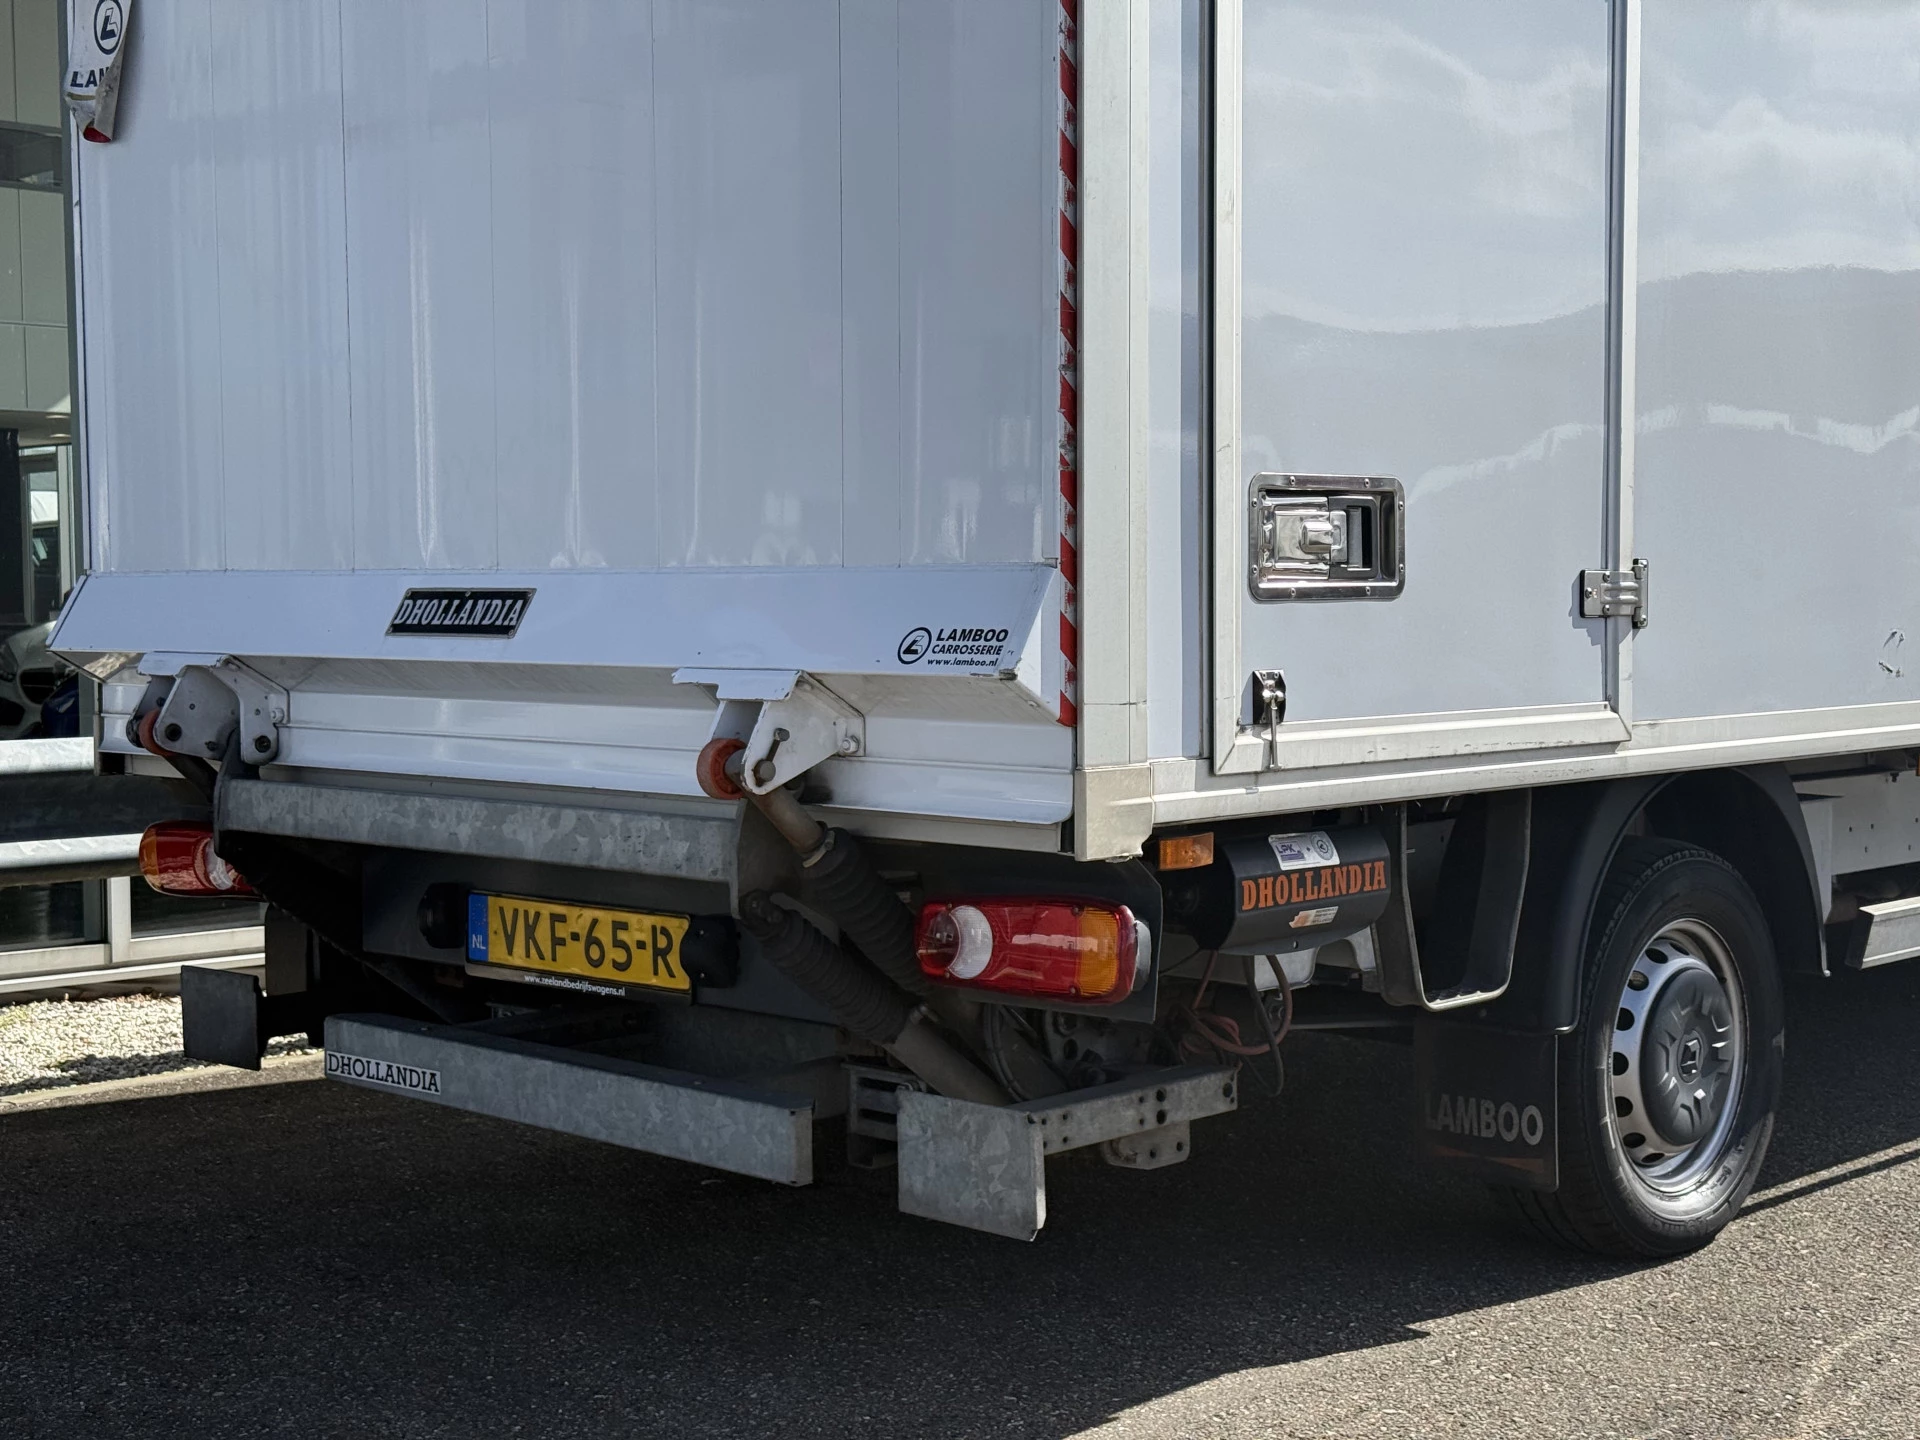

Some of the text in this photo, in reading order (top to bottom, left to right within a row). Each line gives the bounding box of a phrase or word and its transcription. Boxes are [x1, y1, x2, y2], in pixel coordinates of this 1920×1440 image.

[393, 599, 525, 626] DHOLLANDIA
[936, 628, 1009, 642] LAMBOO
[927, 657, 999, 667] www.lamboo.nl
[931, 644, 1004, 656] CARROSSERIE
[1241, 861, 1387, 911] DHOLLANDIA
[472, 934, 486, 949] NL
[498, 906, 677, 978] VKF-65-R
[524, 974, 626, 997] www.zeelandbedrijfswagens.nl
[327, 1053, 440, 1093] DHOLLANDIA
[1424, 1092, 1544, 1146] LAMBOO
